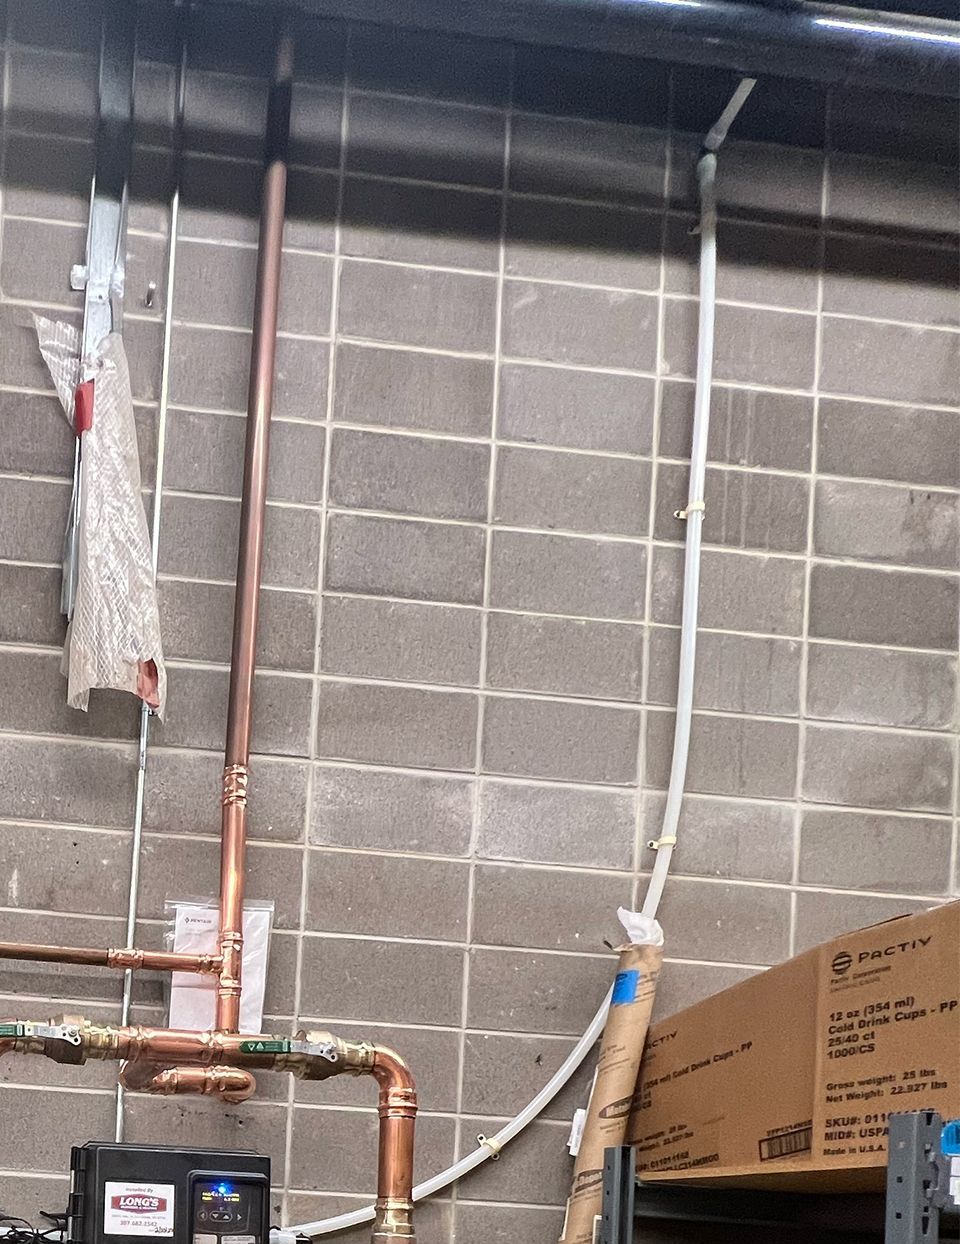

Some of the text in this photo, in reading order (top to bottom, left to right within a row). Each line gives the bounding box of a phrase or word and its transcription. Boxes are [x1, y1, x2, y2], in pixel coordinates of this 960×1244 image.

[858, 935, 933, 963] PACTIV
[828, 1021, 854, 1035] Cold
[858, 1015, 890, 1029] Drink
[894, 1008, 927, 1022] Cups
[939, 1000, 958, 1013] PP
[829, 996, 915, 1022] 12 oz (354 ml)
[828, 1031, 875, 1048] 25/40 ct
[713, 1050, 734, 1063] Cups
[741, 1041, 753, 1052] PP
[827, 1043, 876, 1060] 1000/CS
[826, 1068, 936, 1092] Gross weight: 25 lbs
[826, 1094, 843, 1104] Net
[846, 1089, 884, 1102] Weight:
[931, 1080, 948, 1090] lbs
[825, 1116, 861, 1129] SKU#:
[825, 1131, 856, 1141] MID#:
[824, 1144, 887, 1156] Made in U.S.A.
[120, 1196, 159, 1207] LONG'S
